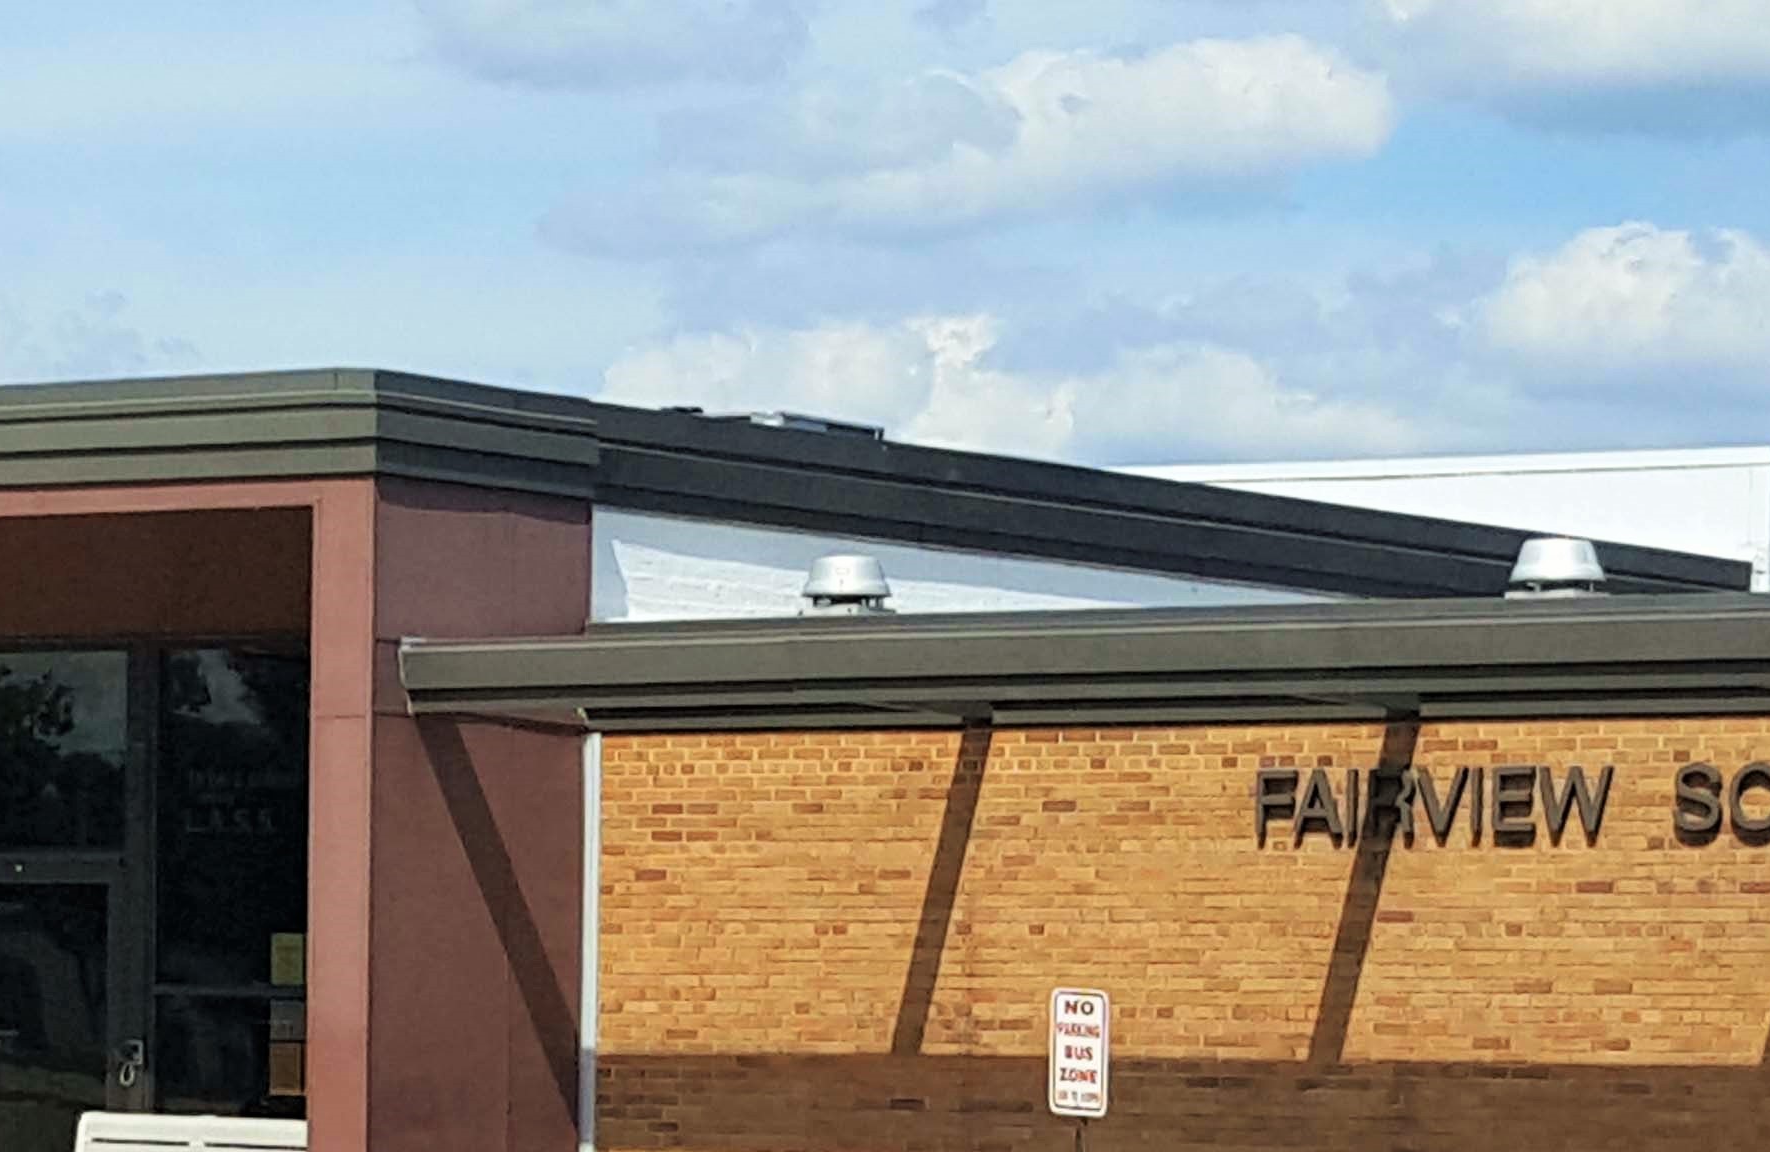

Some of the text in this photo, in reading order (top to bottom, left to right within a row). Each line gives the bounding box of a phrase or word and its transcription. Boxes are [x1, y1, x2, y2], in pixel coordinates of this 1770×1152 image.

[1256, 765, 1614, 849] FAIRVIEW
[1065, 1000, 1094, 1015] NO
[1065, 1045, 1093, 1060] BUS
[1060, 1067, 1097, 1083] ZONE
